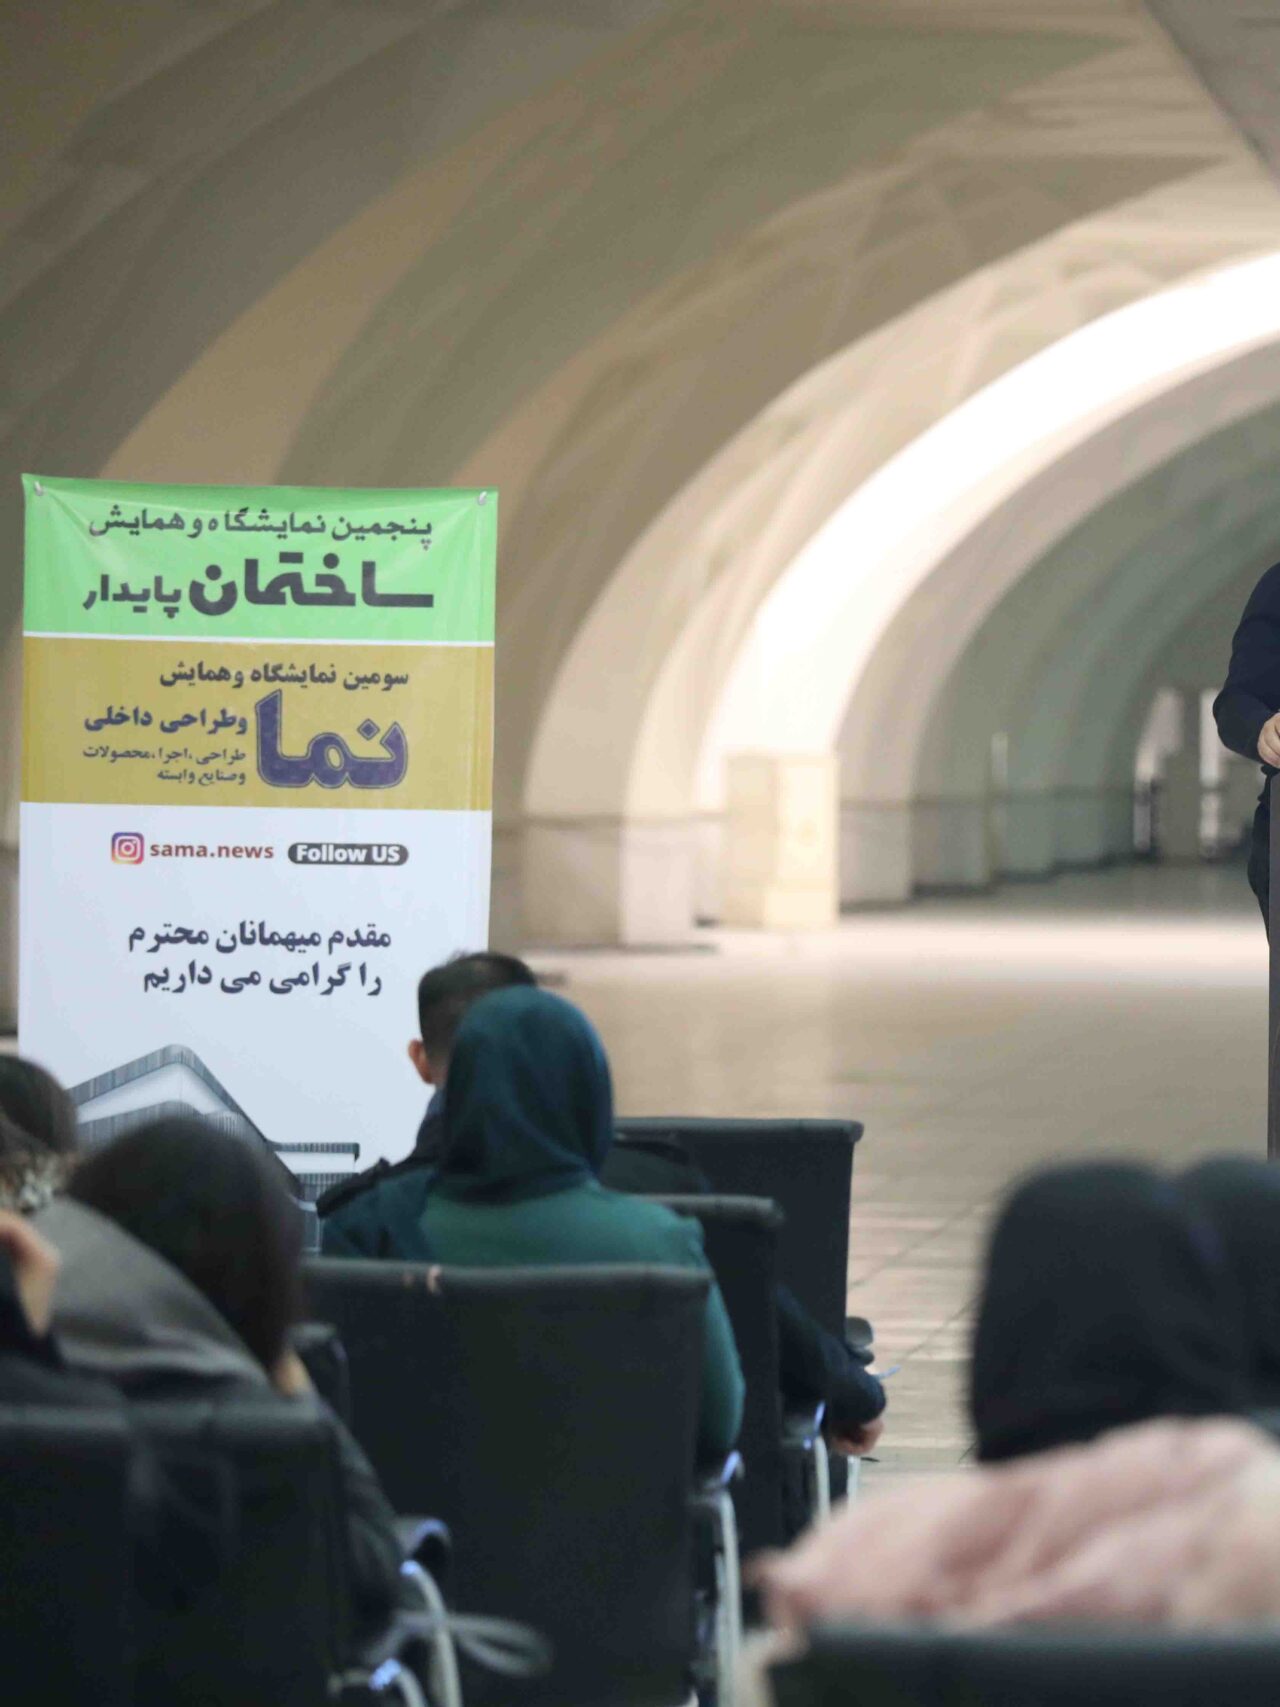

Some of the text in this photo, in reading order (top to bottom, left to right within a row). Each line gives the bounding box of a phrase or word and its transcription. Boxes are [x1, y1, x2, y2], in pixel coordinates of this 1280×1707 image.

[208, 506, 326, 540] نمایشگاه
[331, 516, 432, 551] پنجمین
[82, 551, 434, 619] ساختمان پایدار
[250, 662, 337, 689] نمایشگاه
[343, 668, 409, 691] سومین
[84, 705, 153, 732] داخلی
[254, 688, 409, 790] نما
[157, 768, 195, 785] وابسته
[150, 842, 274, 859] sama.news
[296, 844, 400, 863] Follow US
[129, 920, 391, 955] مقدم میهمانان محترم
[269, 961, 352, 996] گرامی
[358, 961, 382, 996] را
